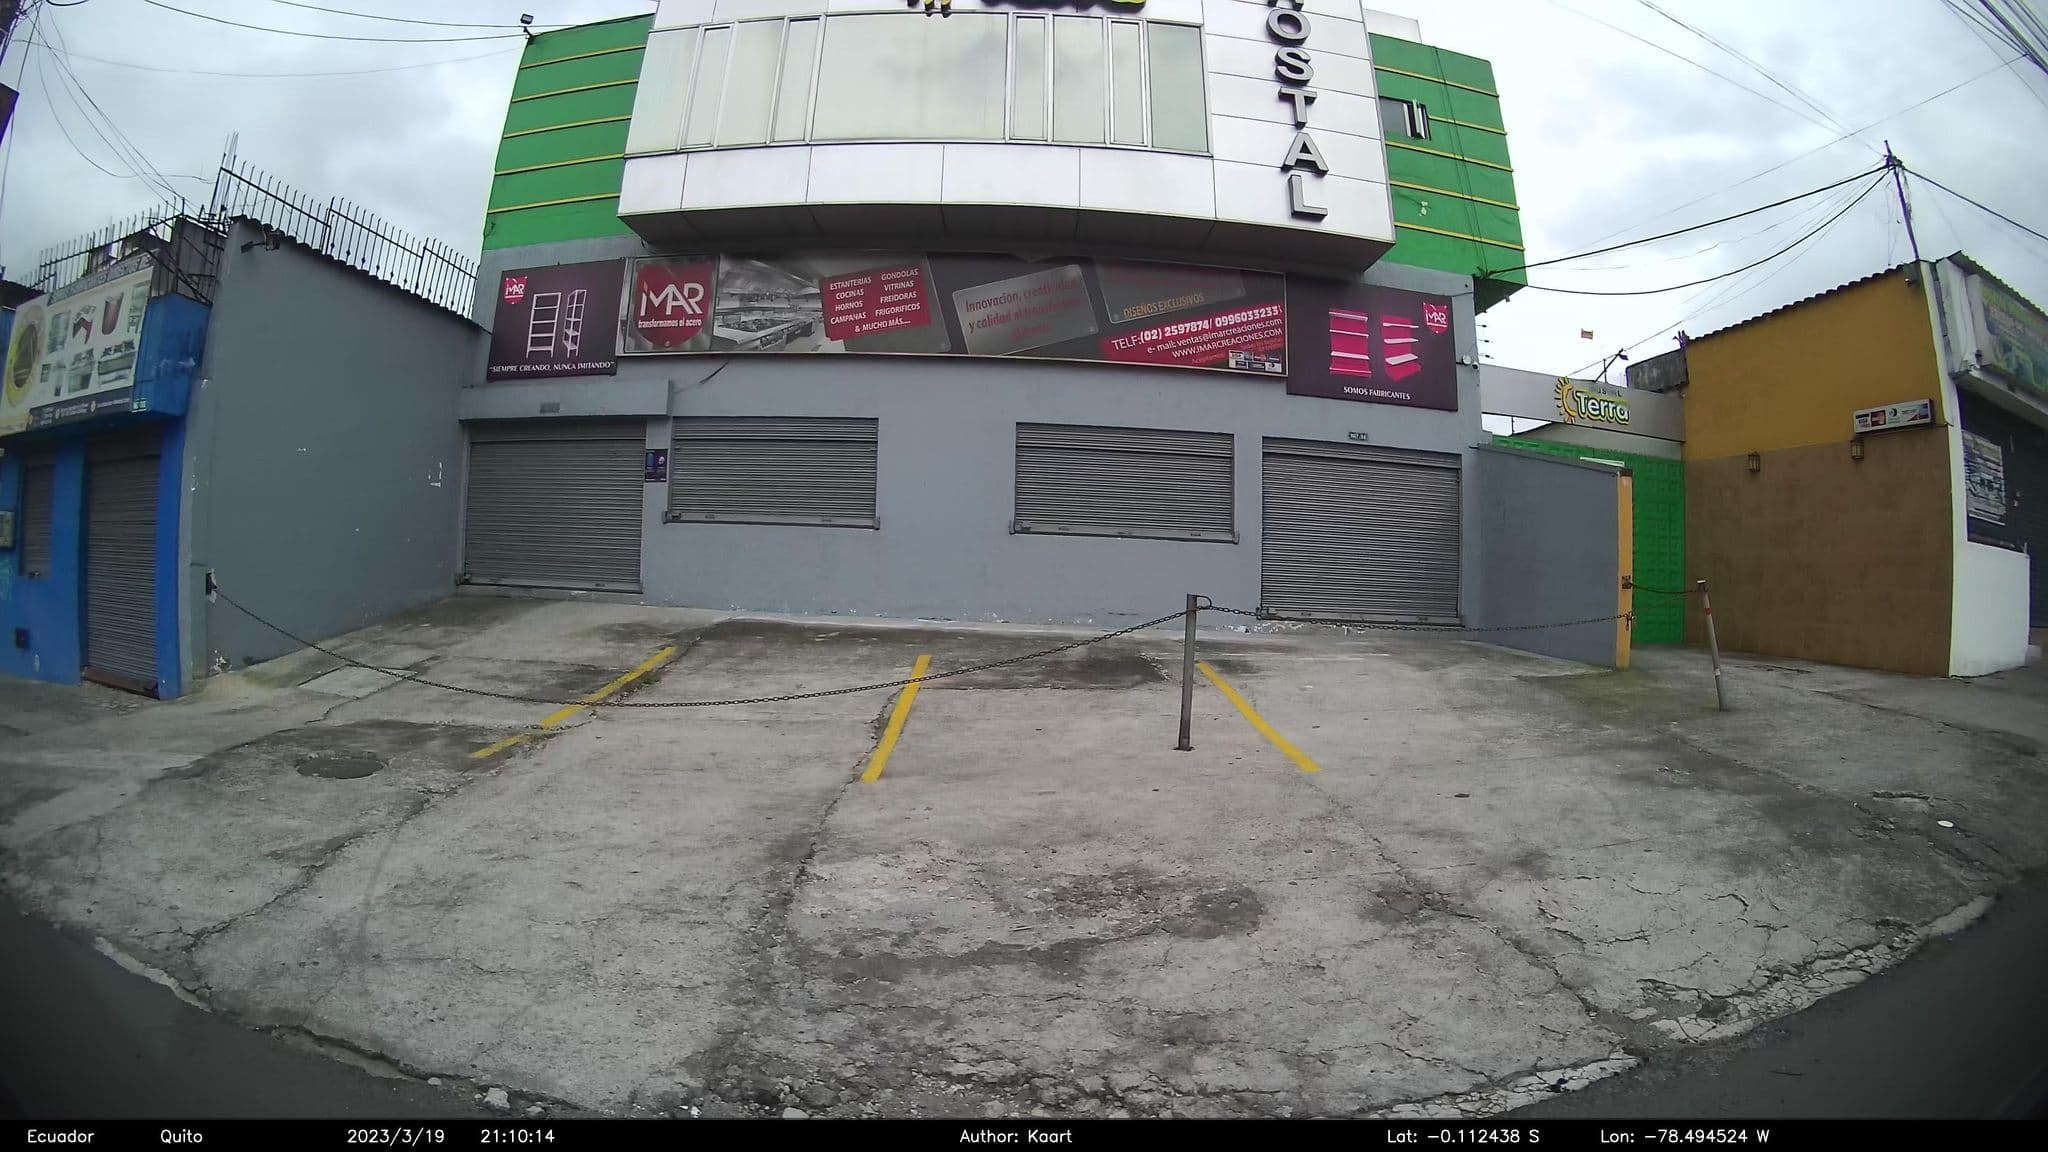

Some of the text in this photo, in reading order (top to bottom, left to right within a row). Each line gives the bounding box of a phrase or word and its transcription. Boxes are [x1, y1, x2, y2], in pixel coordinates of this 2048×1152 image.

[881, 268, 919, 281] GONDOLAS
[830, 276, 872, 291] ESTANTERIAS
[884, 280, 915, 292] VITRINAS
[835, 288, 865, 300] COCINAS
[880, 291, 917, 304] FREIDORAS
[835, 301, 864, 312] HORNOS
[875, 302, 921, 317] FRIGORIFICOS
[638, 319, 702, 329] transformamos el acero
[830, 311, 867, 325] CAMPANAS
[854, 325, 861, 333] &
[862, 320, 888, 331] MUCHO
[553, 361, 577, 370] NUNCA
[1343, 386, 1411, 400] SOMOS FABRICANTES
[1575, 390, 1630, 425] Terra
